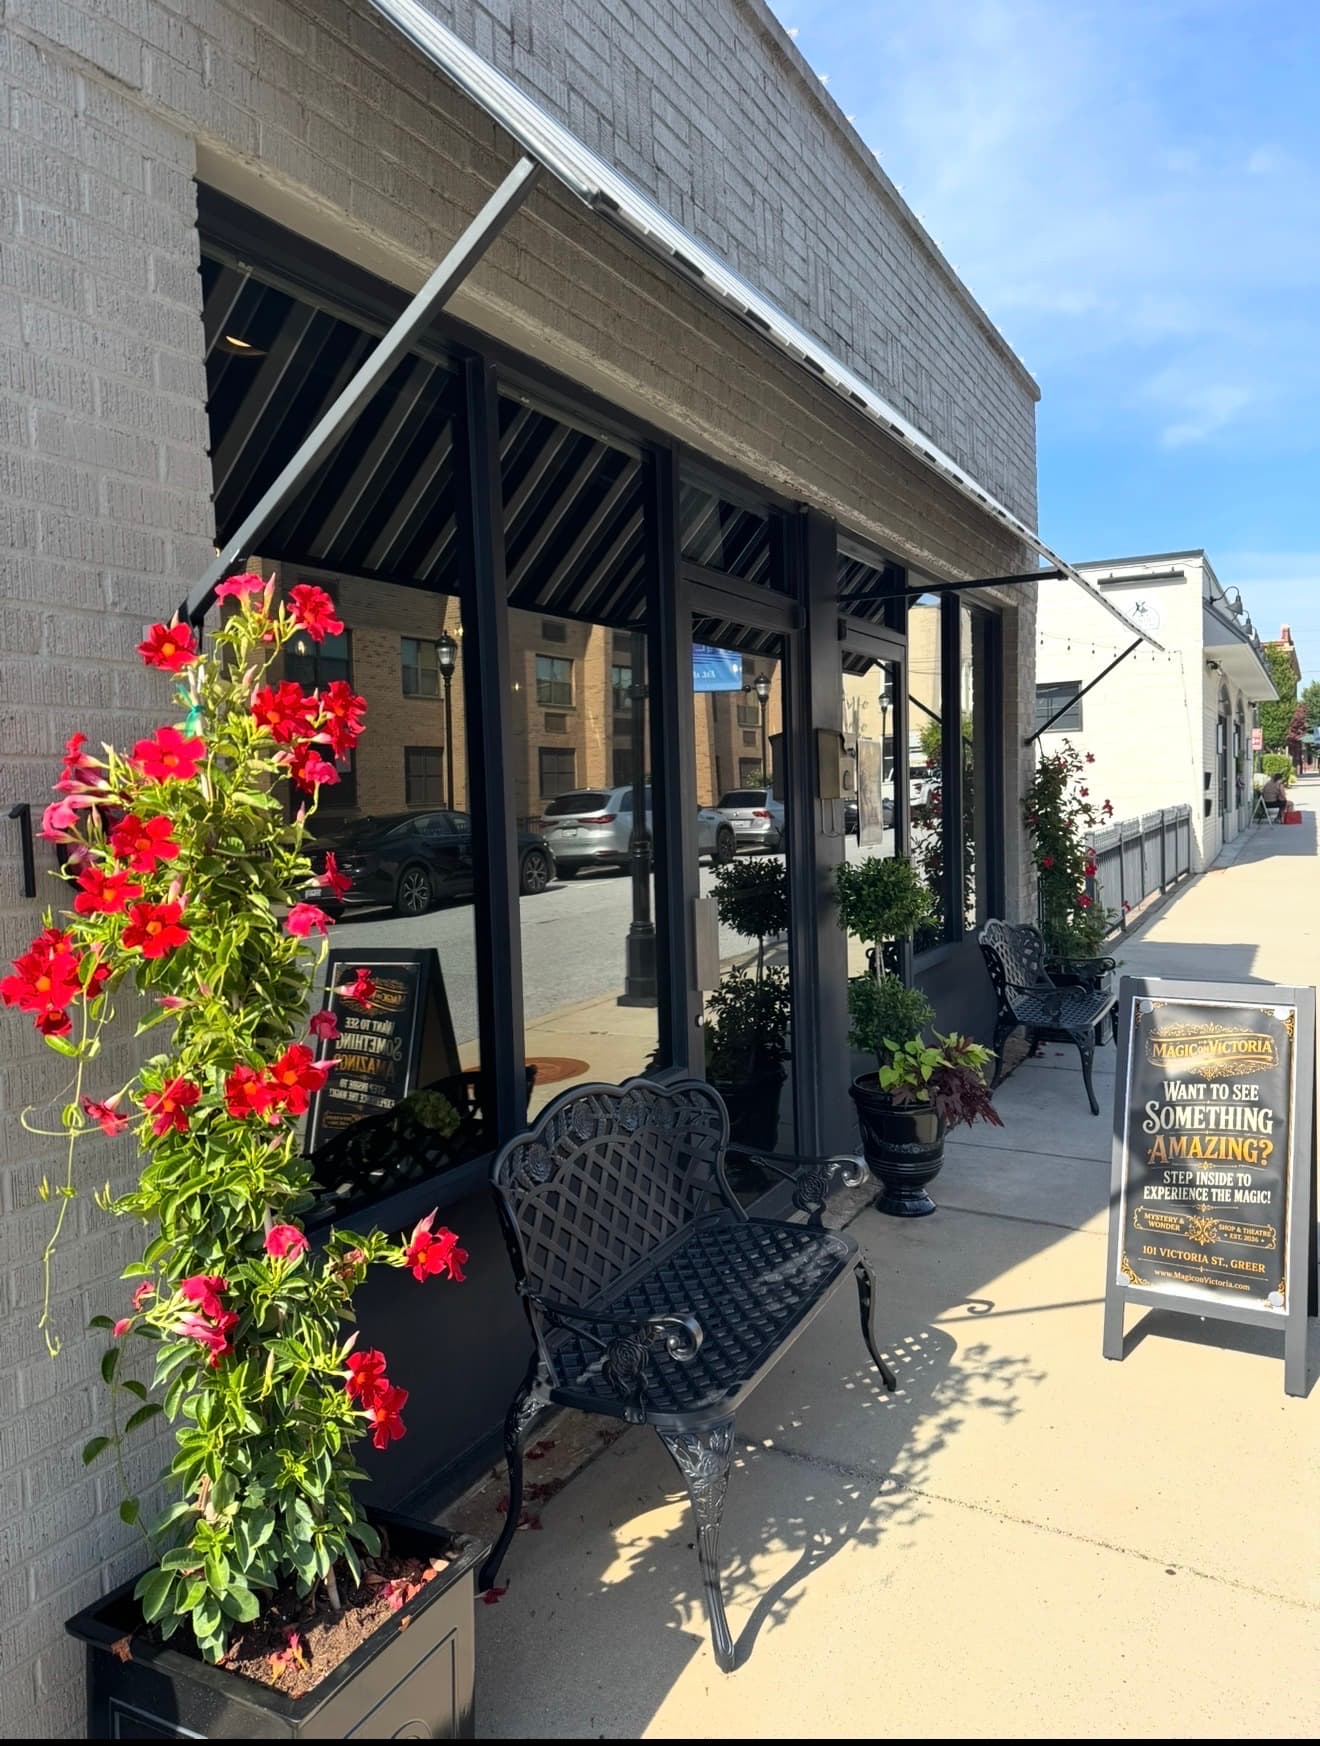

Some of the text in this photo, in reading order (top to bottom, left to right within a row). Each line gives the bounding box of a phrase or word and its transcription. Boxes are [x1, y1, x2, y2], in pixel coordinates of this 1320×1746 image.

[1152, 1043, 1197, 1057] MAGIC
[1208, 1040, 1273, 1056] VICTORIA
[1163, 1080, 1260, 1101] WANT TO SEE
[1142, 1100, 1274, 1134] SOMETHING
[1147, 1134, 1274, 1166] AMAZING?
[1163, 1171, 1252, 1187] STEP INSIDE TO
[1143, 1185, 1271, 1204] EXPERIENCE THE MAGIC!
[1144, 1213, 1178, 1223] MYSTERY
[1148, 1220, 1181, 1231] WONDER
[1218, 1223, 1236, 1232] SHOP
[1243, 1227, 1272, 1238] THEATRE
[1142, 1245, 1157, 1256] 101
[1159, 1247, 1209, 1264] VICTORIA
[1230, 1259, 1266, 1273] GREER
[1154, 1269, 1251, 1291] www.MagiconVictoria.com
